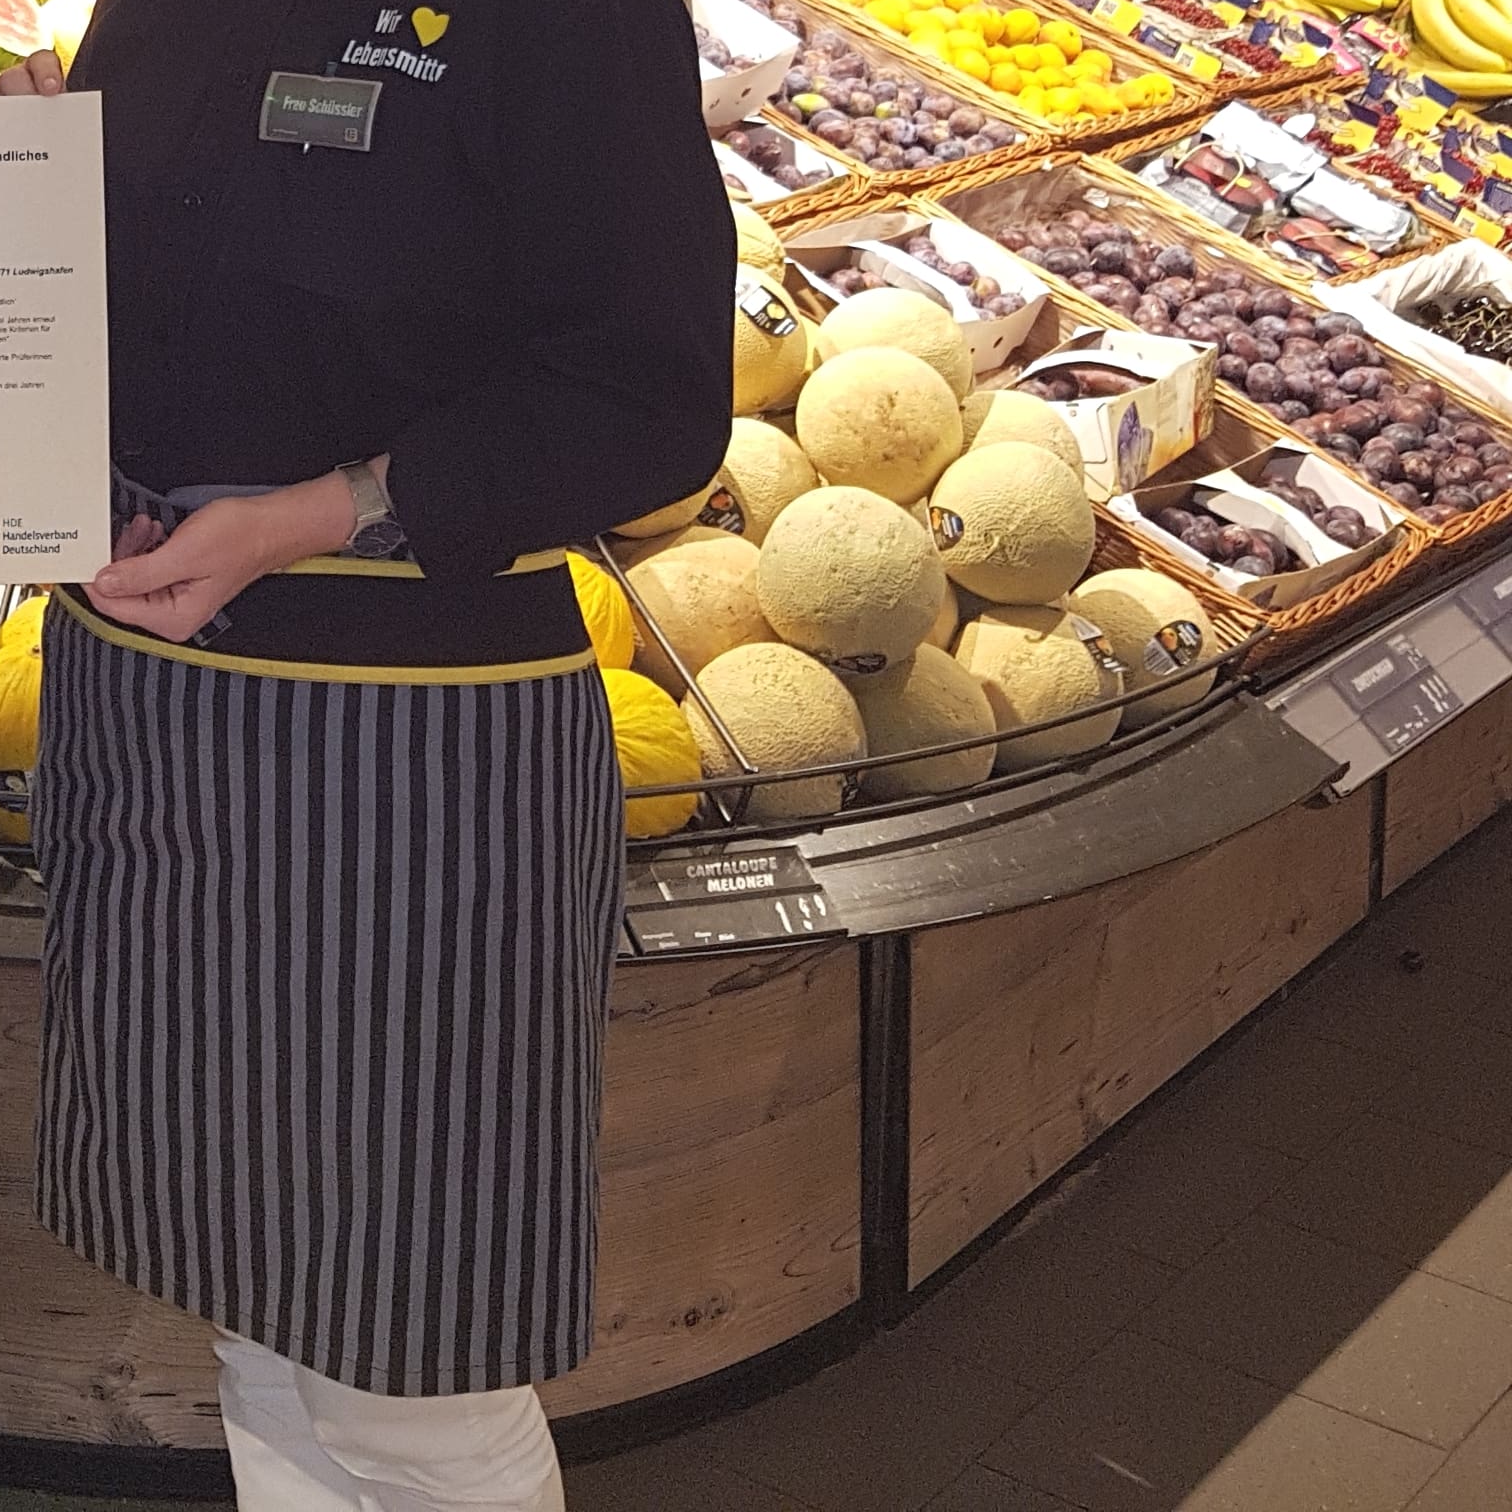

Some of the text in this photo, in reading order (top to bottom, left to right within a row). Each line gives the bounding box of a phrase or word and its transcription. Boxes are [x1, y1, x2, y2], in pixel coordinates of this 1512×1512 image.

[374, 9, 403, 34] Wir
[2, 518, 23, 527] HDE
[2, 530, 78, 540] Handelsverband
[2, 544, 60, 554] Deutschland
[686, 856, 778, 878] CANTALOUPE
[707, 873, 775, 893] MELONEN
